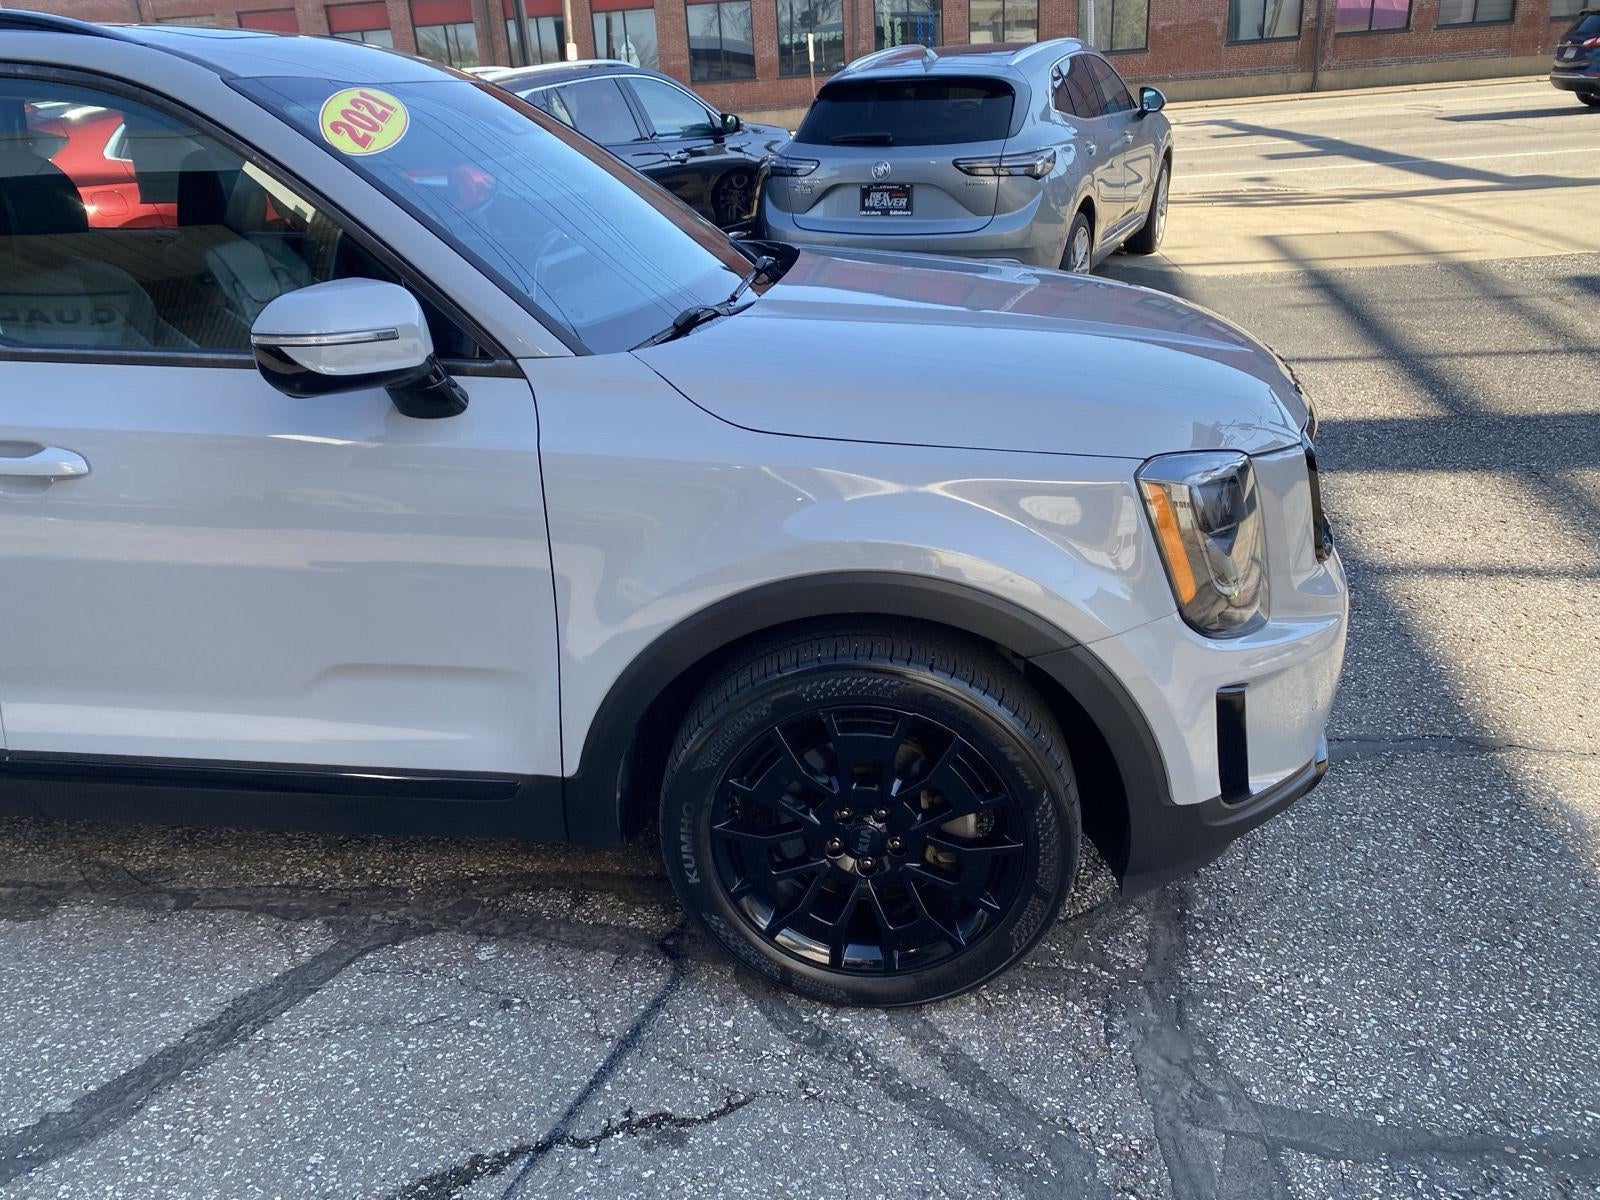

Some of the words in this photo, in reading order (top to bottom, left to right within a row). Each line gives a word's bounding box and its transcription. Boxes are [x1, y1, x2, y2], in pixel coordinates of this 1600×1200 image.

[330, 91, 397, 149] 2021
[865, 198, 907, 206] WEAVER
[681, 801, 700, 884] KUMHO
